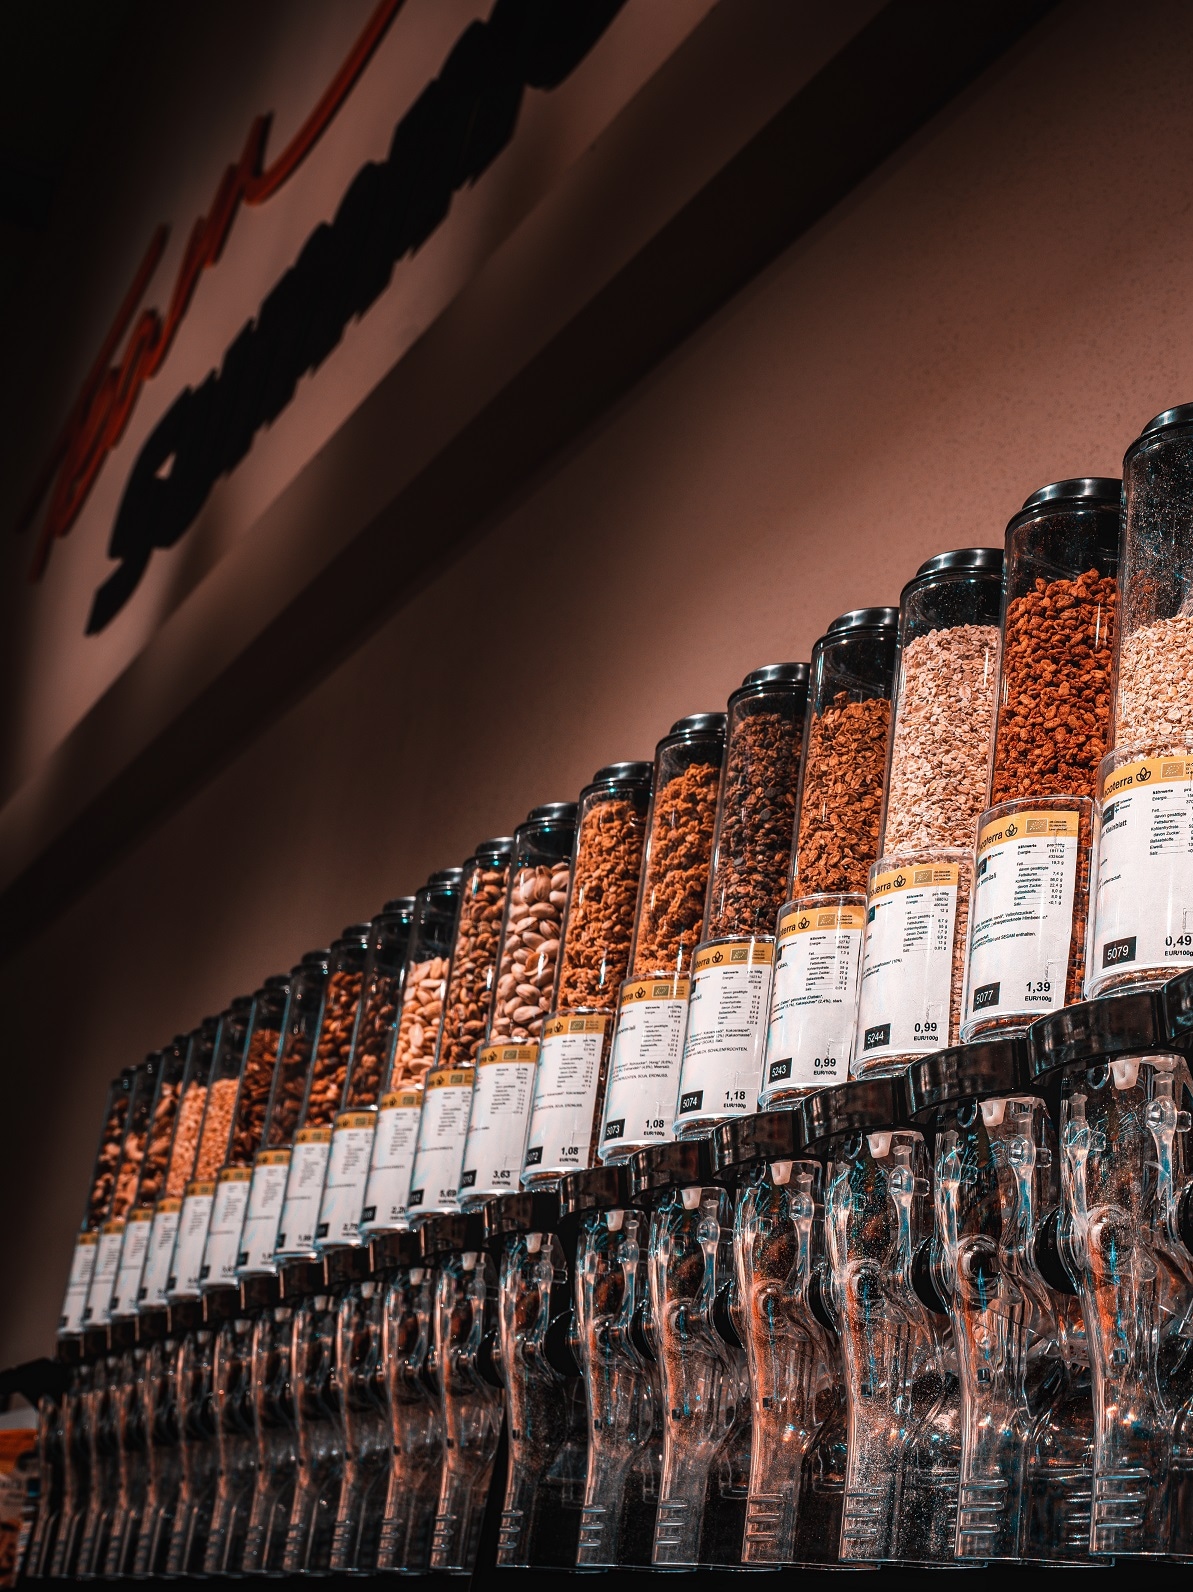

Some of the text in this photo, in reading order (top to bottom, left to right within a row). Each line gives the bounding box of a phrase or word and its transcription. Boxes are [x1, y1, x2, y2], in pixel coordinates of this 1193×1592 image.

[1165, 935, 1192, 948] 0,49
[1107, 945, 1128, 961] 5079
[1026, 981, 1051, 993] 1,39
[976, 990, 993, 1004] 5077
[914, 1022, 937, 1033] 0,99
[867, 1031, 884, 1044] 5244
[815, 1058, 836, 1068] 0,99
[772, 1064, 786, 1077] 5243
[725, 1091, 746, 1101] 1,18
[646, 1120, 664, 1129] 1,08
[562, 1147, 578, 1156] 1,08
